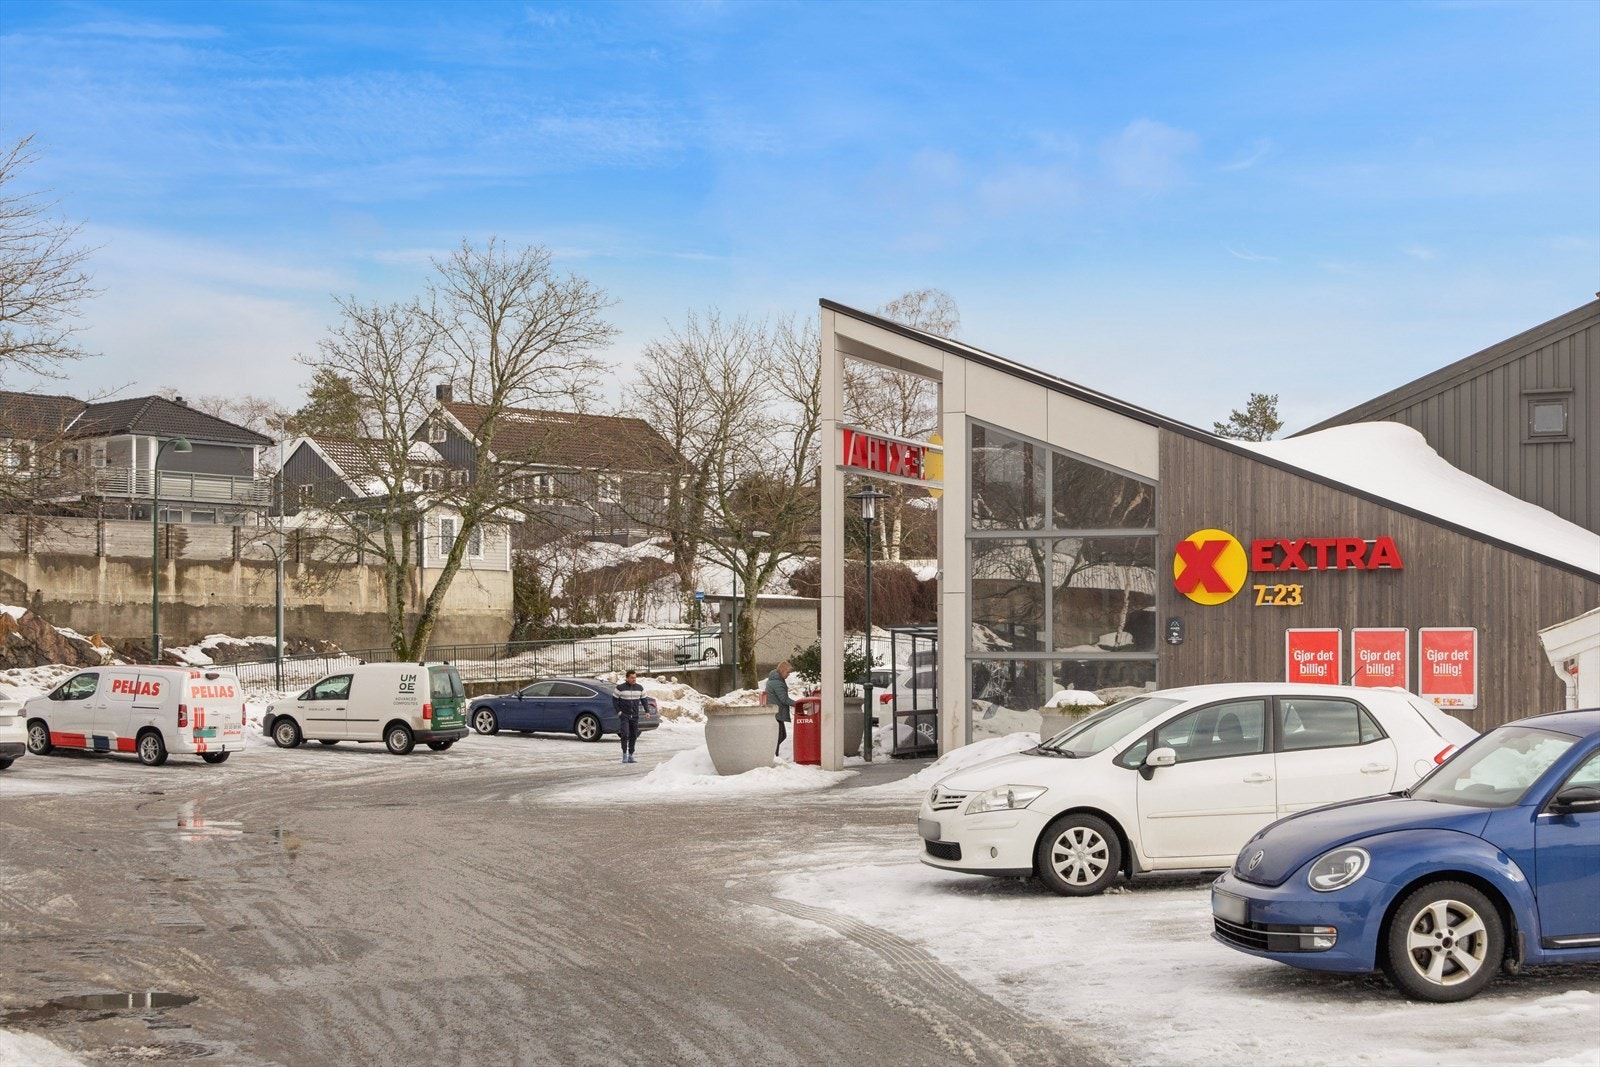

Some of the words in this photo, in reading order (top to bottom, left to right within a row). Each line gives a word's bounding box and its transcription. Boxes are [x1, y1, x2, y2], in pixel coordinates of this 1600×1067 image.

[1251, 536, 1404, 572] EXTRA
[1253, 583, 1303, 607] 7-23
[1293, 649, 1315, 663] Gjør
[1316, 649, 1334, 661] det
[1359, 649, 1382, 663] Gjør
[1383, 649, 1401, 661] det
[1426, 649, 1449, 662] Gjør
[1450, 649, 1469, 661] det
[1299, 663, 1328, 676] billig!
[1366, 663, 1395, 676] billig!
[1433, 663, 1462, 676] billig!
[400, 674, 417, 682] UM
[112, 679, 160, 696] PELIAS
[191, 685, 235, 699] PELIAS
[399, 683, 415, 691] OE
